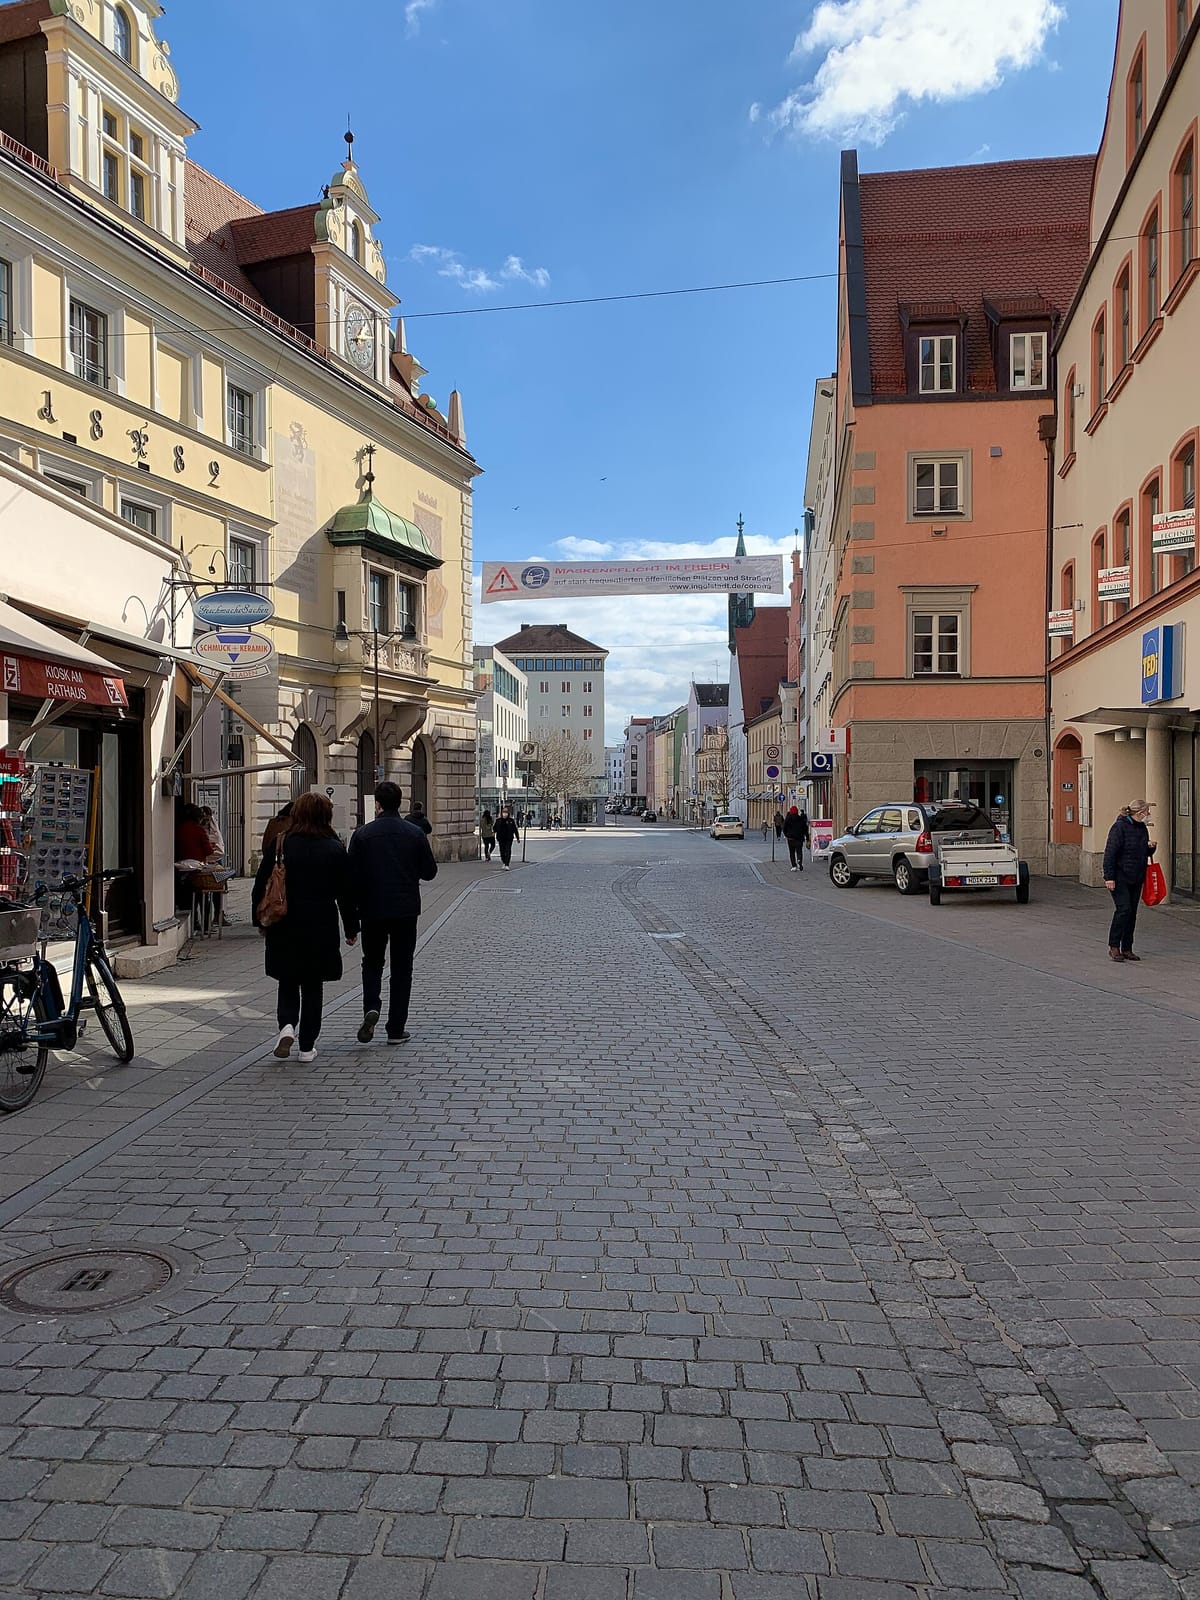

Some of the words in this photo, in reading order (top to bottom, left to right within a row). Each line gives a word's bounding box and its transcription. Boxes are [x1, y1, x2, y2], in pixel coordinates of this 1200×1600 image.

[665, 564, 680, 572] IM
[684, 562, 730, 572] FREIEN
[723, 574, 739, 582] und
[740, 574, 772, 583] Straßen
[200, 644, 231, 652] SCHMUCK
[45, 665, 71, 682] KIOSK
[71, 671, 84, 684] AM
[47, 682, 87, 700] RATHAUS
